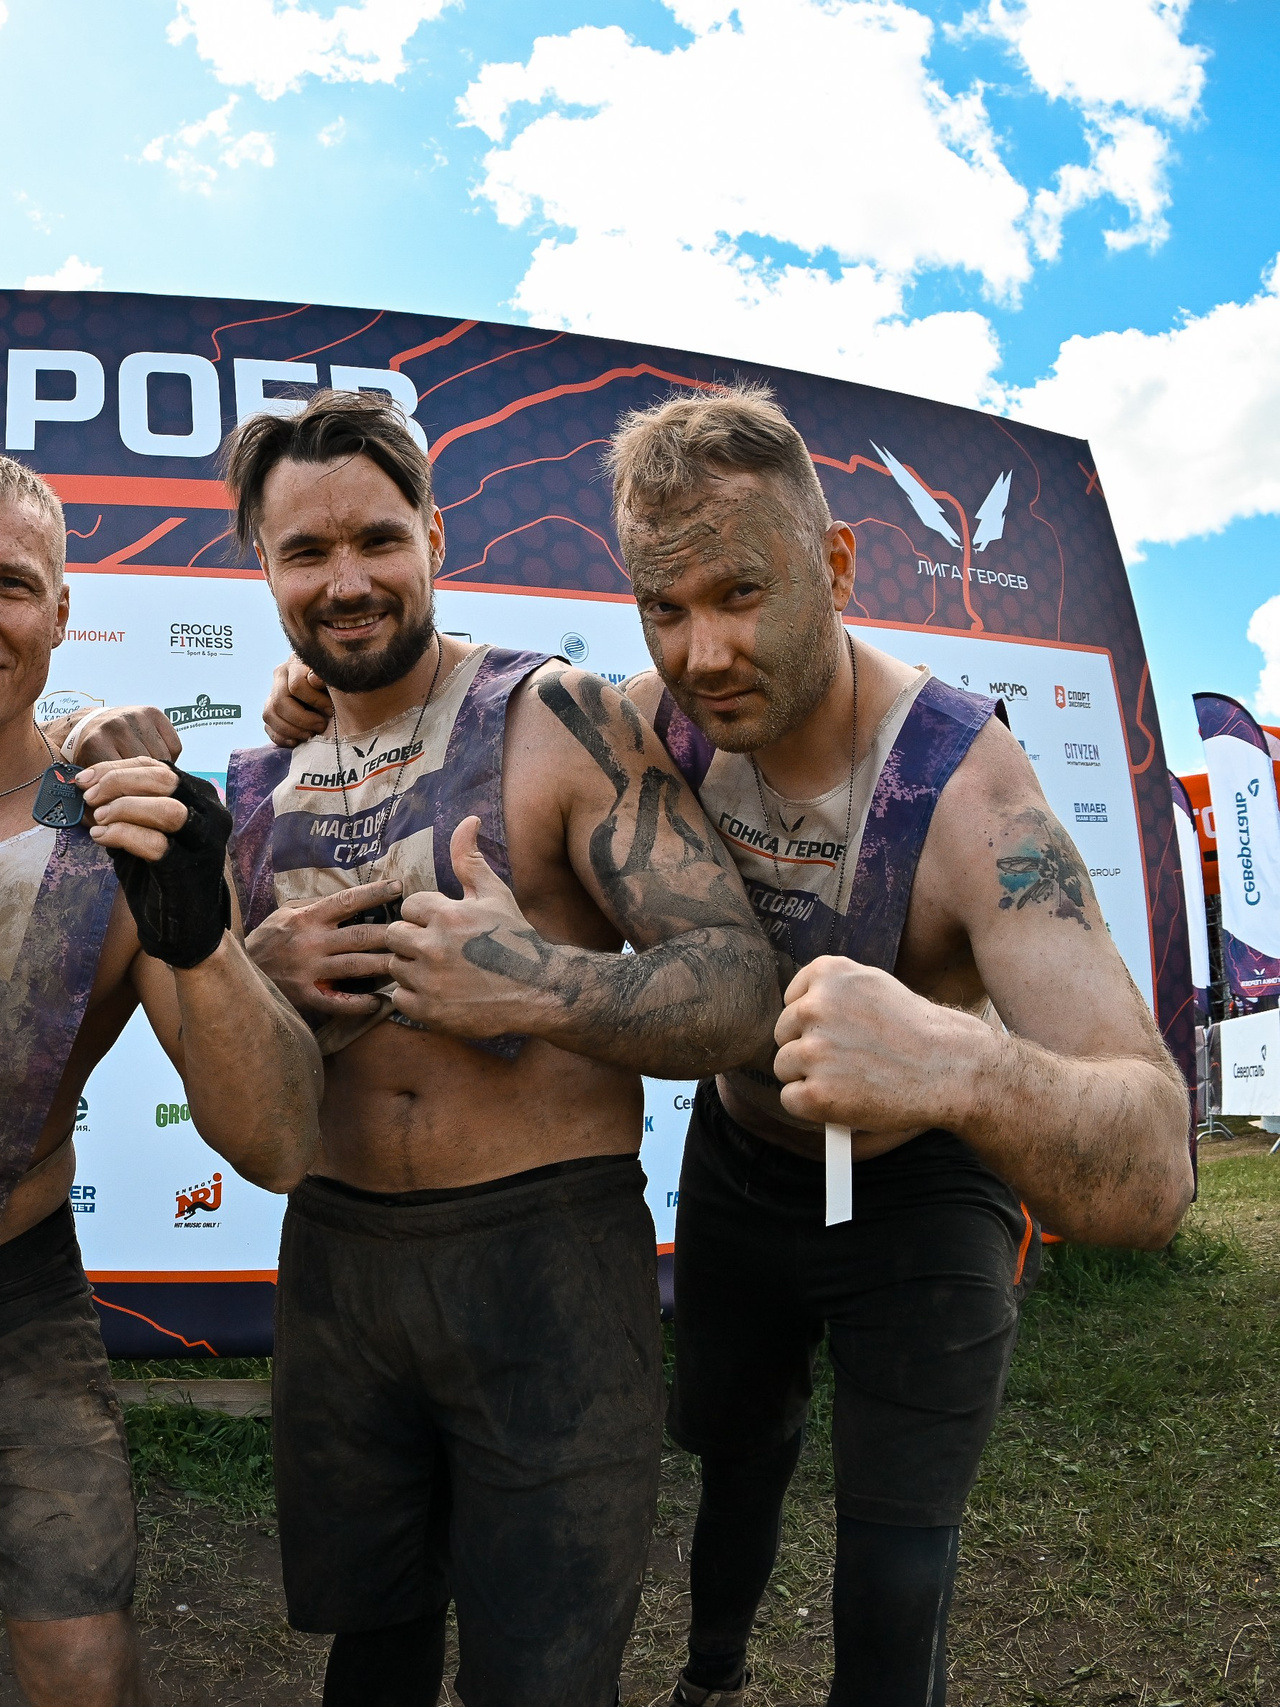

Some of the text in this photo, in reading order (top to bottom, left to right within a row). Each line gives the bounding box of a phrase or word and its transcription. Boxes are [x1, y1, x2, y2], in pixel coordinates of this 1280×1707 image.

[918, 560, 1028, 590] ЛИГА ГЕРОЕВ
[63, 630, 125, 642] ПИОНАТ
[170, 623, 233, 636] CROCUS
[990, 683, 1028, 697] МАГУРО
[1068, 690, 1090, 702] СПОРТ
[1068, 701, 1091, 709] ЭКСПРЕСС
[171, 710, 189, 725] Dr.
[1064, 743, 1100, 761] CITYZEN
[300, 740, 423, 787] ГОНКА ГЕРОЕВ
[1081, 804, 1107, 814] MAER
[719, 812, 779, 854] ГОНКА
[1089, 868, 1121, 877] GROUP
[1234, 1063, 1265, 1083] Северсталь
[175, 1179, 212, 1196] ENERGY
